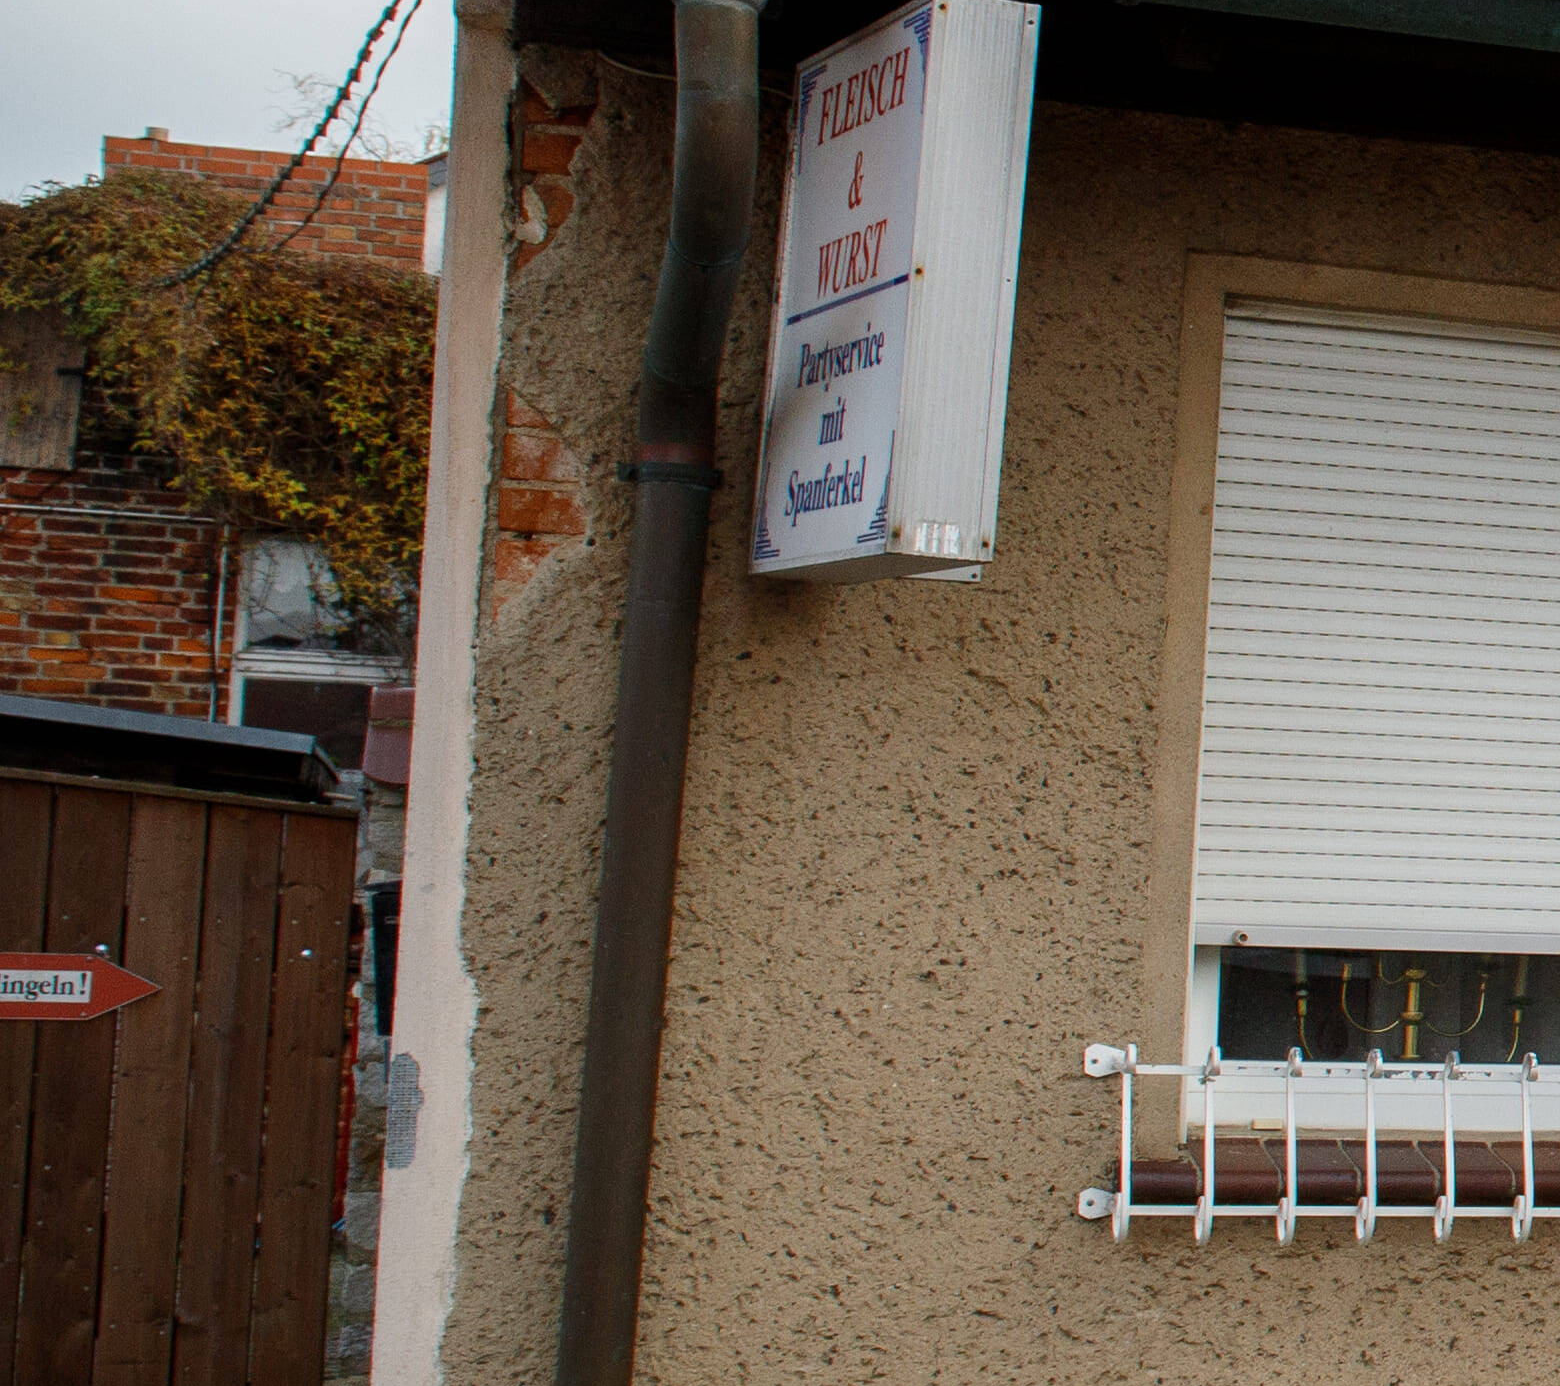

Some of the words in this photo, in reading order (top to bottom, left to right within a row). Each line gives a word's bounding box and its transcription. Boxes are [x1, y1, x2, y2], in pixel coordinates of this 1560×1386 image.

[817, 47, 911, 146] FLEISCH
[847, 150, 865, 210] &
[817, 218, 889, 300] WURST
[797, 321, 885, 392] Partyservice
[818, 396, 847, 445] mit
[783, 455, 867, 527] Spanferkel
[0, 972, 88, 1001] ingeln!
